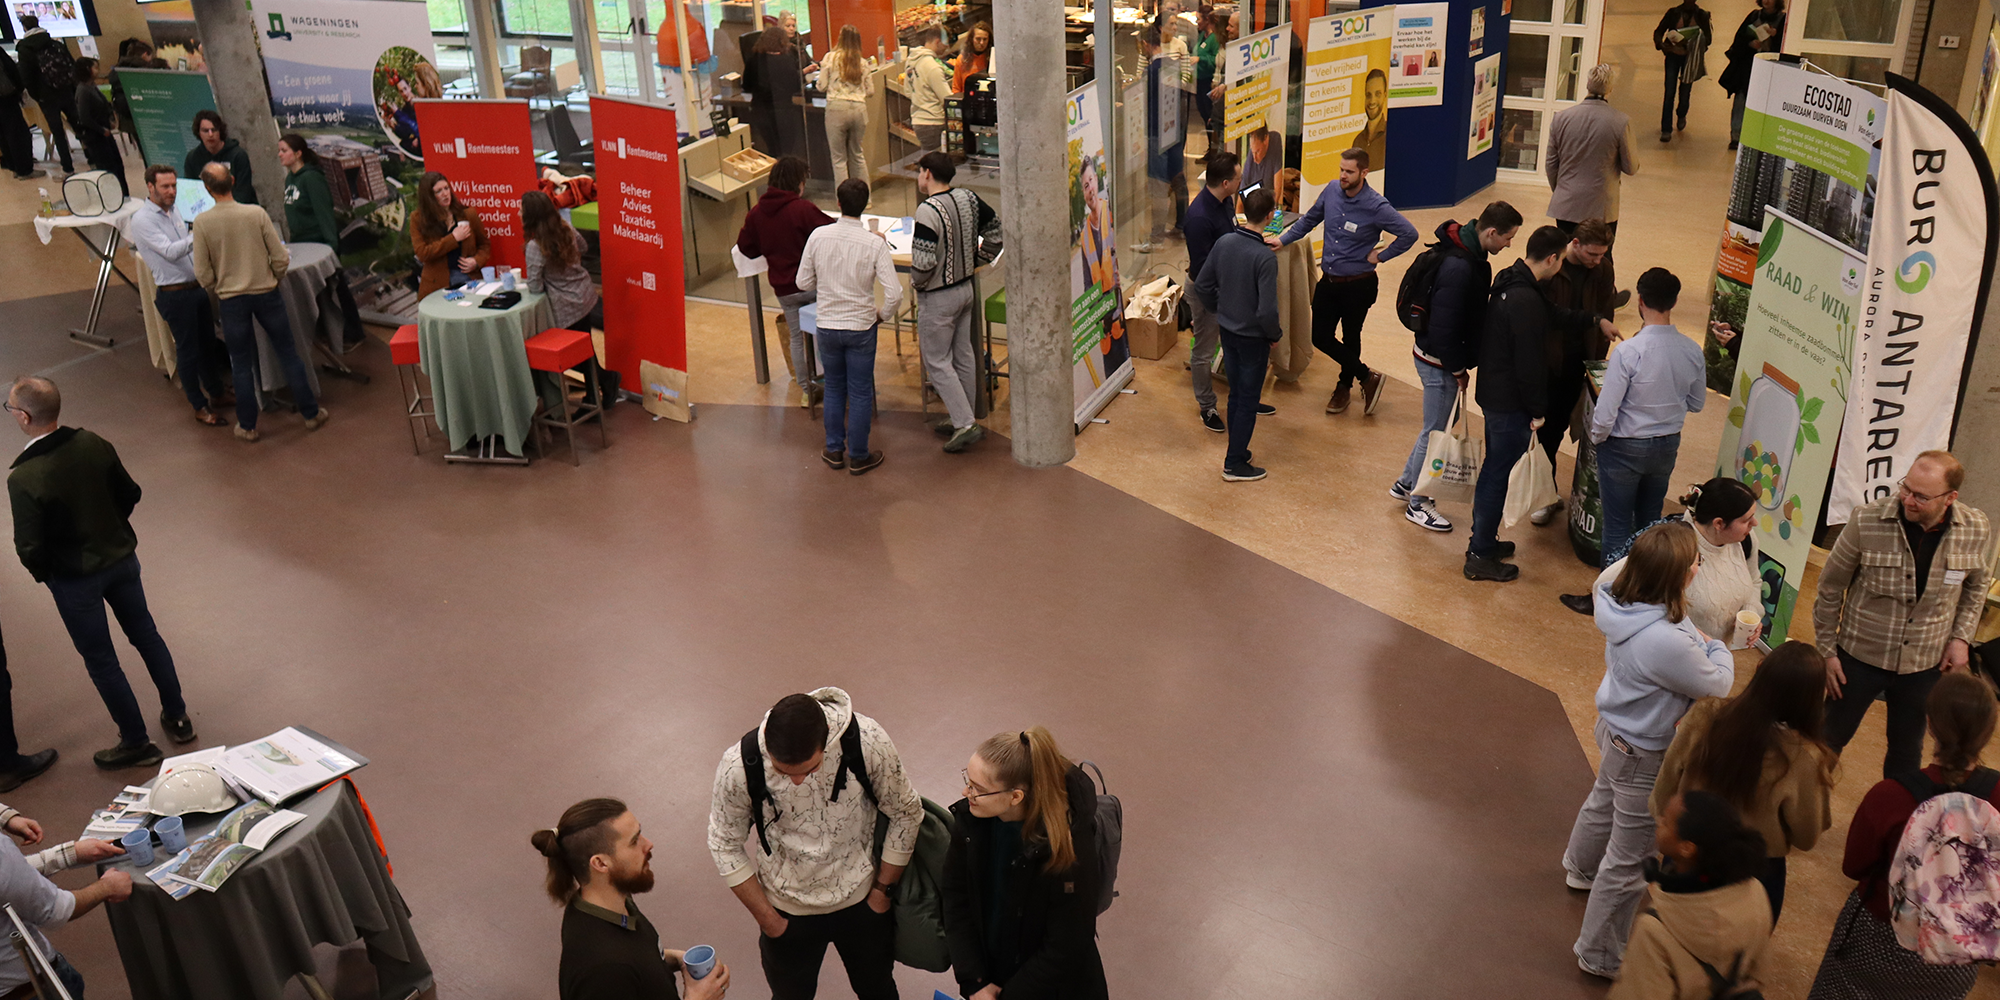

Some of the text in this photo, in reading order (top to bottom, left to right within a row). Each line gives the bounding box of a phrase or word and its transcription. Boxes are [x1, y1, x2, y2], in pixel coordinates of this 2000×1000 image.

[290, 16, 359, 29] WAGENINGEN
[1330, 14, 1375, 38] BOOT
[293, 29, 324, 37] UNIVERSITY
[330, 30, 361, 38] RESEARCH
[1239, 33, 1280, 67] BOOT
[1333, 59, 1362, 75] vrijheid
[284, 75, 332, 90] Een groene
[1227, 81, 1268, 102] Werken aan een
[1309, 82, 1346, 98] en kennis
[281, 89, 352, 109] campus waar jij
[1066, 93, 1085, 125] OT
[1226, 94, 1279, 120] toekomstbestendige
[1803, 84, 1852, 117] ECOSTAD
[285, 108, 346, 129] je thuis voelt
[1309, 101, 1345, 118] om jezelf
[1782, 101, 1848, 131] DUURZAAM DURVEN DOEN
[1226, 118, 1262, 139] leefomgeving
[1307, 128, 1317, 138] te
[1778, 124, 1786, 133] De
[1786, 127, 1804, 139] groene
[1804, 132, 1815, 142] stad
[433, 142, 520, 155] VLNN Rentmeesters
[601, 139, 668, 163] VLNN Rentmeesters
[1775, 144, 1807, 158] waterbeheer
[1777, 135, 1793, 144] urban
[1793, 139, 1804, 148] heat
[450, 180, 513, 196] Wij kennen
[620, 181, 652, 199] Beheer
[460, 195, 502, 208] waarde
[622, 197, 652, 214] Advies
[619, 210, 656, 230] Taxaties
[613, 223, 664, 250] Makelaardij
[1766, 261, 1850, 324] RAAD & WIN
[1863, 267, 1885, 342] AURORA
[1756, 302, 1780, 323] Hoeveel
[1779, 315, 1807, 340] inheemse
[1768, 325, 1827, 366] zitten er in de vaas?
